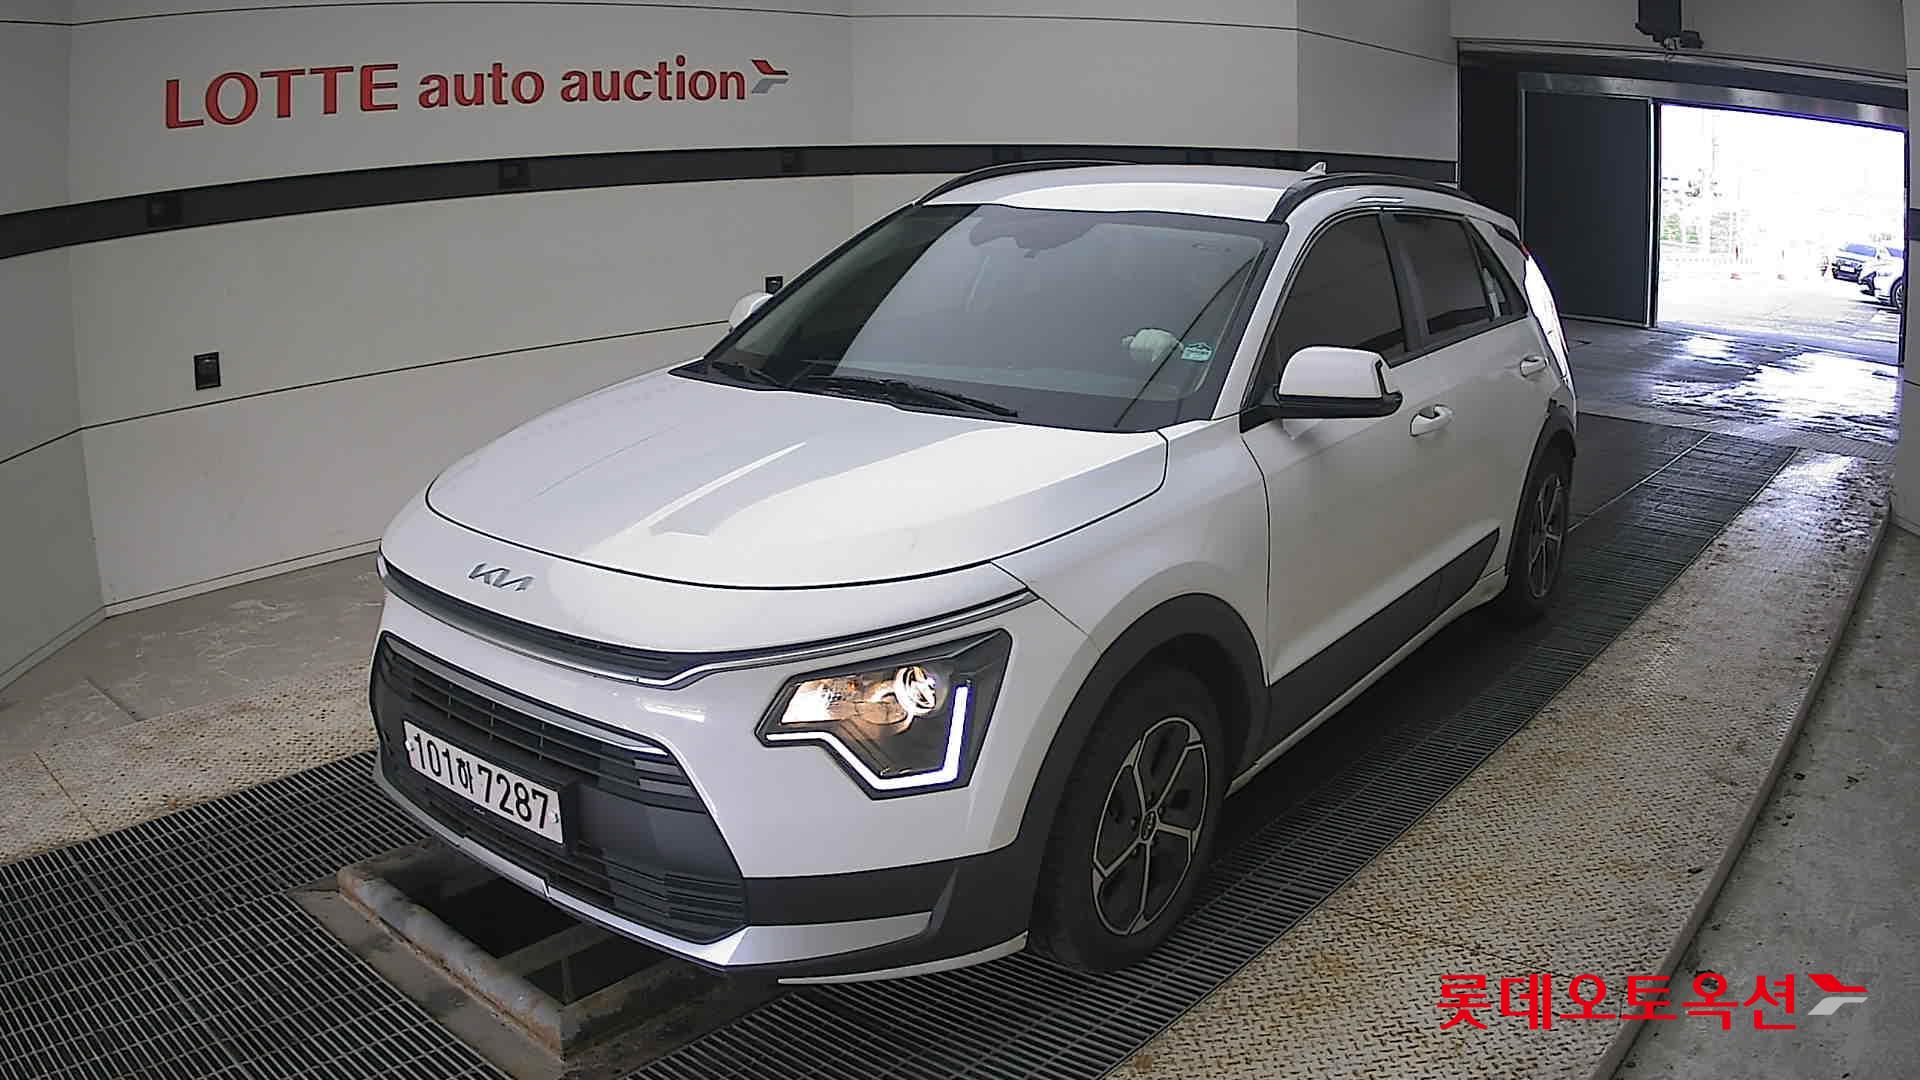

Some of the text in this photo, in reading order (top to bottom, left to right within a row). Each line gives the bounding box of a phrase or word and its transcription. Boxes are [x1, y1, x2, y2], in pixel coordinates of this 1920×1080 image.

[164, 55, 747, 129] LOTTE auto auction
